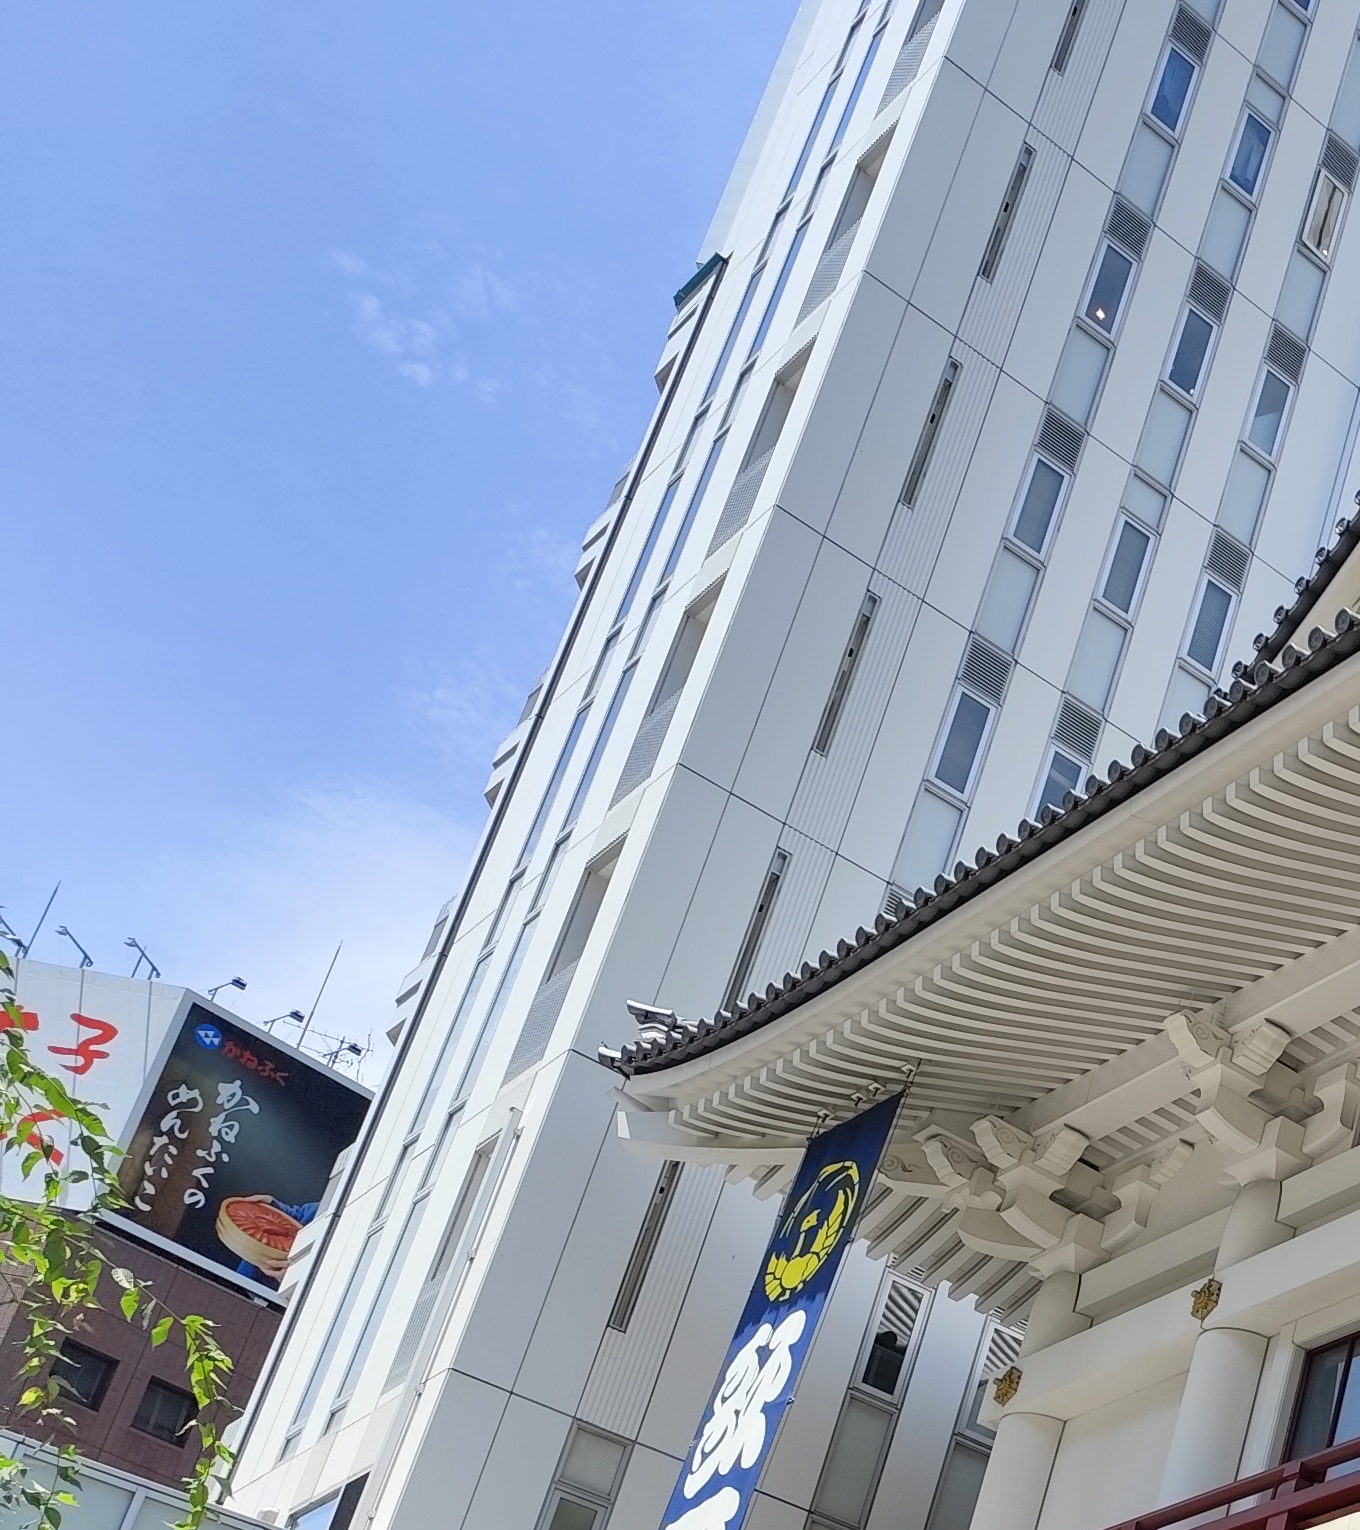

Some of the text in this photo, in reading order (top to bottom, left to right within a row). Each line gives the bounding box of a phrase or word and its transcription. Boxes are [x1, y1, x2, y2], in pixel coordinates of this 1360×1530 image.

[222, 1040, 289, 1087] かねふく
[134, 1083, 204, 1212] めんたいこ
[183, 1080, 260, 1209] かねふくの
